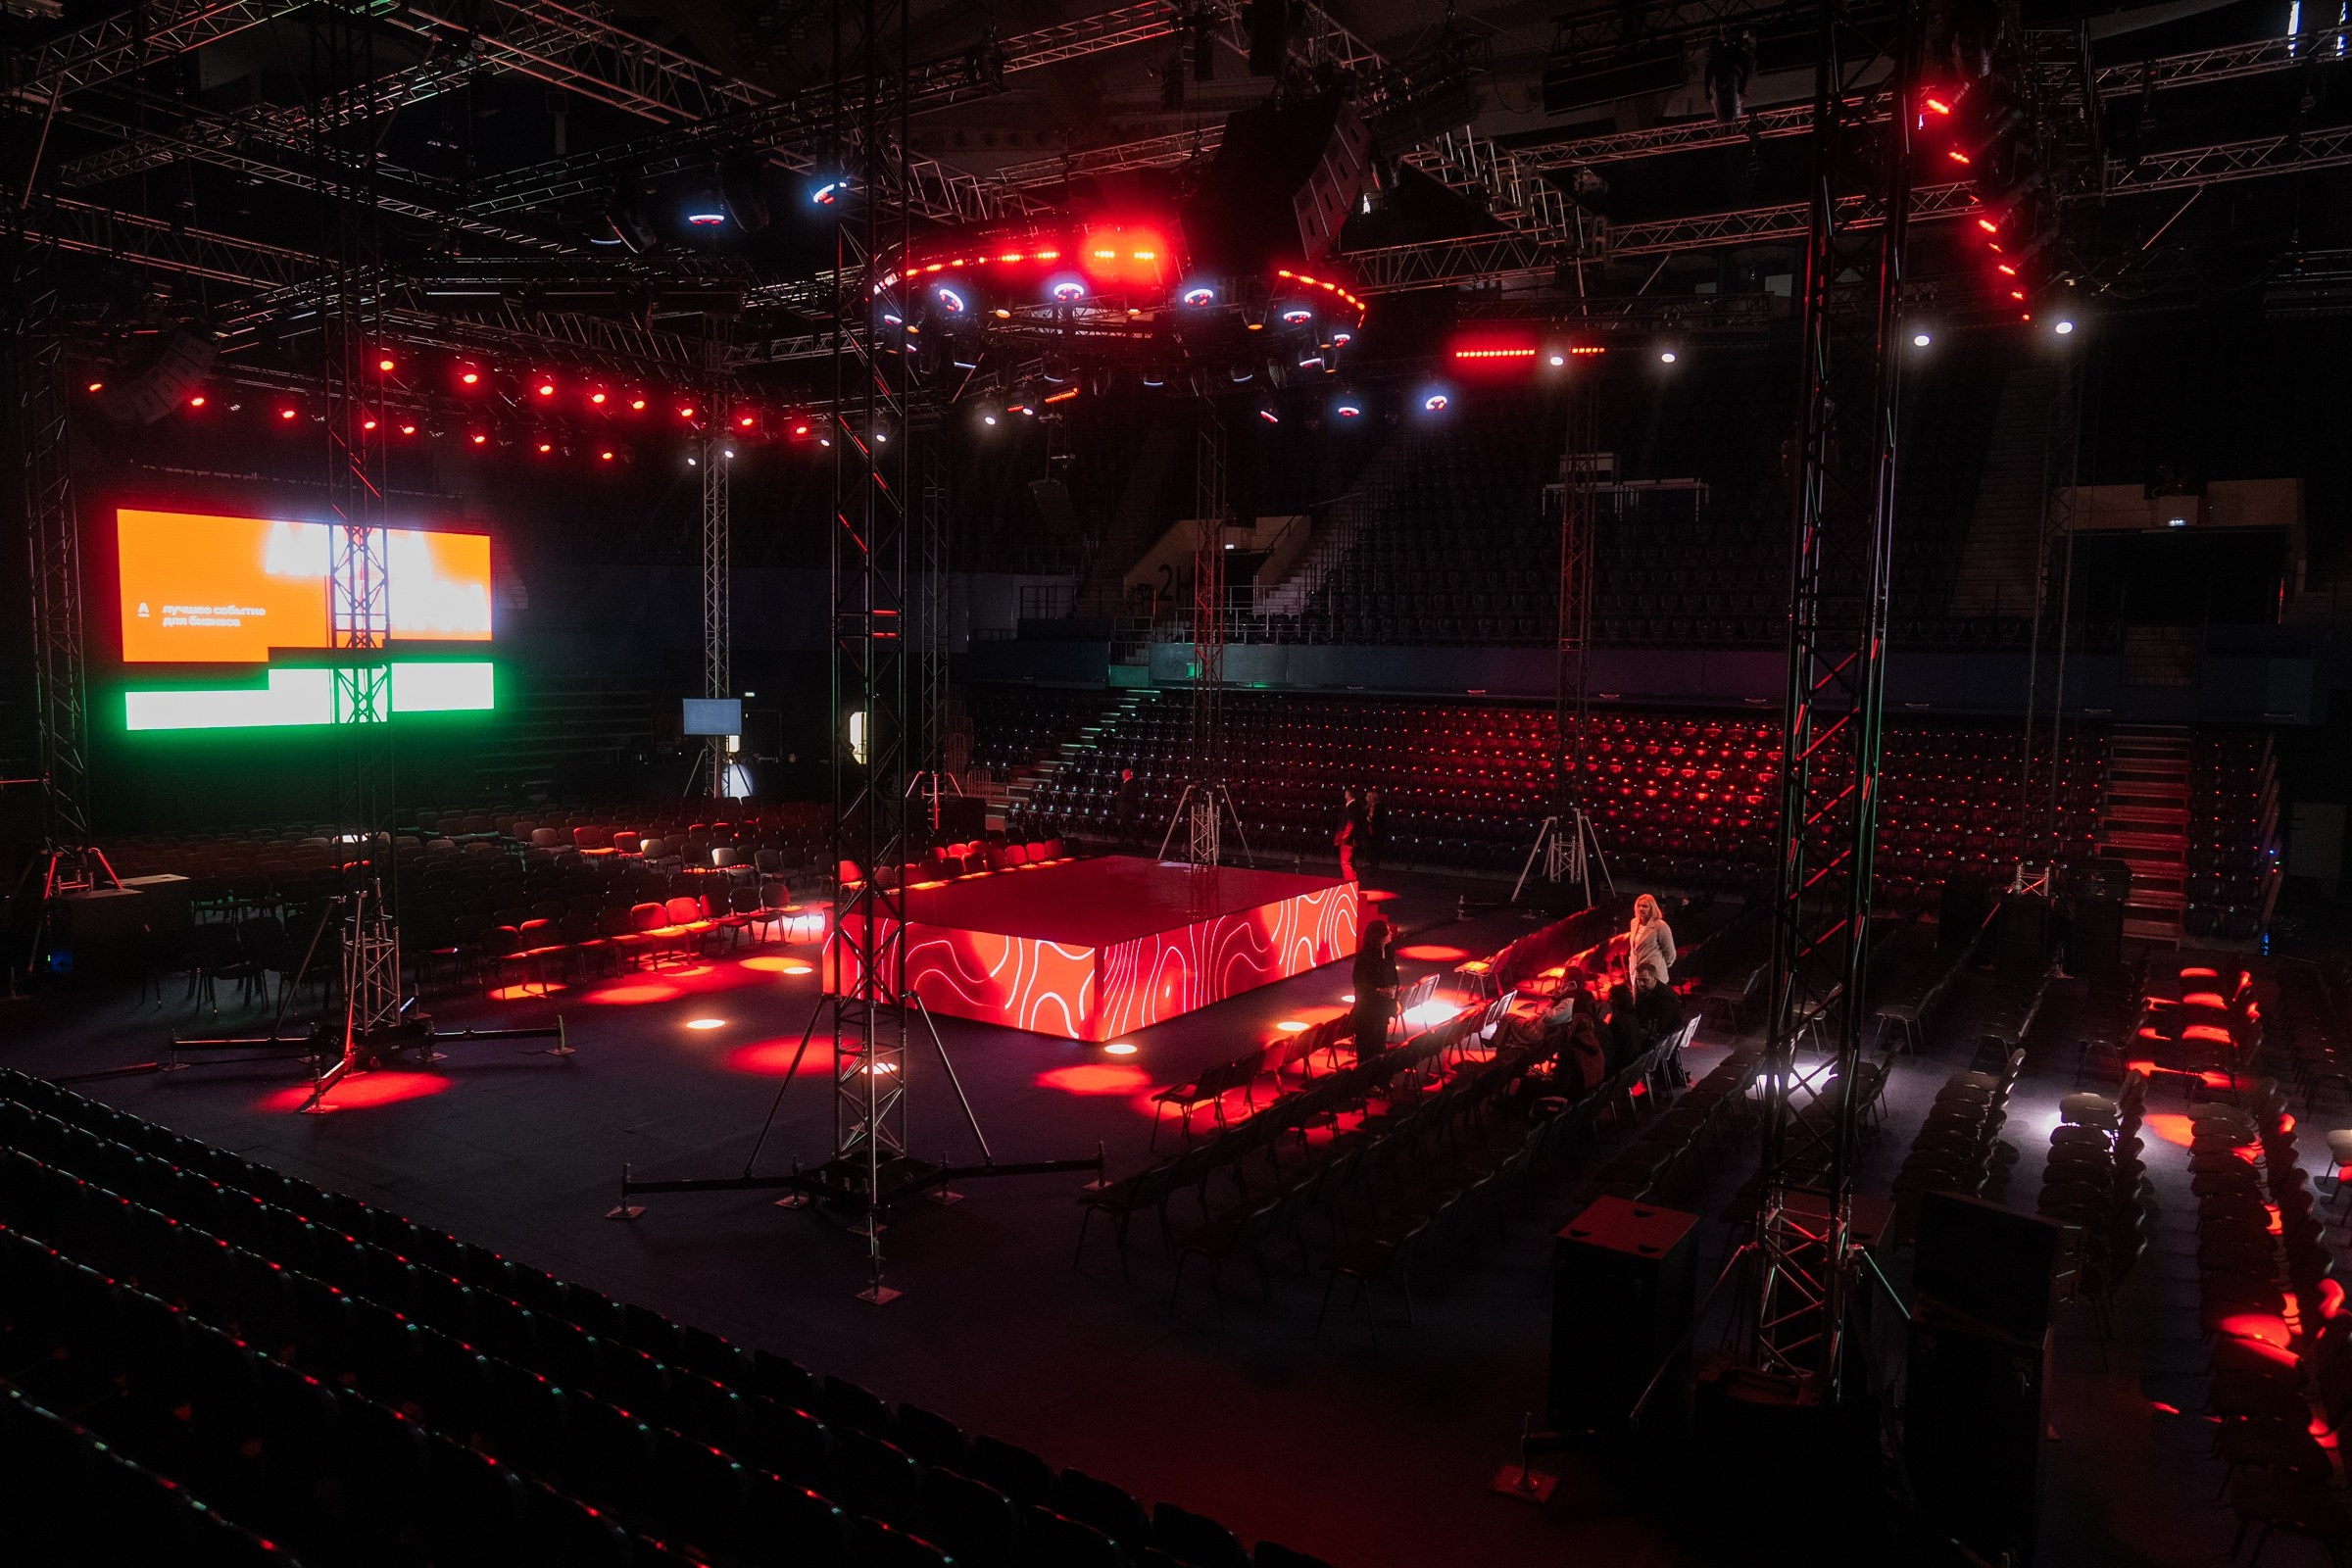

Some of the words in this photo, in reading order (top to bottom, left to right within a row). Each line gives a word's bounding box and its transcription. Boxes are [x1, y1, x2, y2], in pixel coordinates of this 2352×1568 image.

[162, 605, 213, 616] лучшее
[213, 604, 267, 616] событие
[162, 616, 188, 627] для
[188, 614, 241, 627] бизнеса
